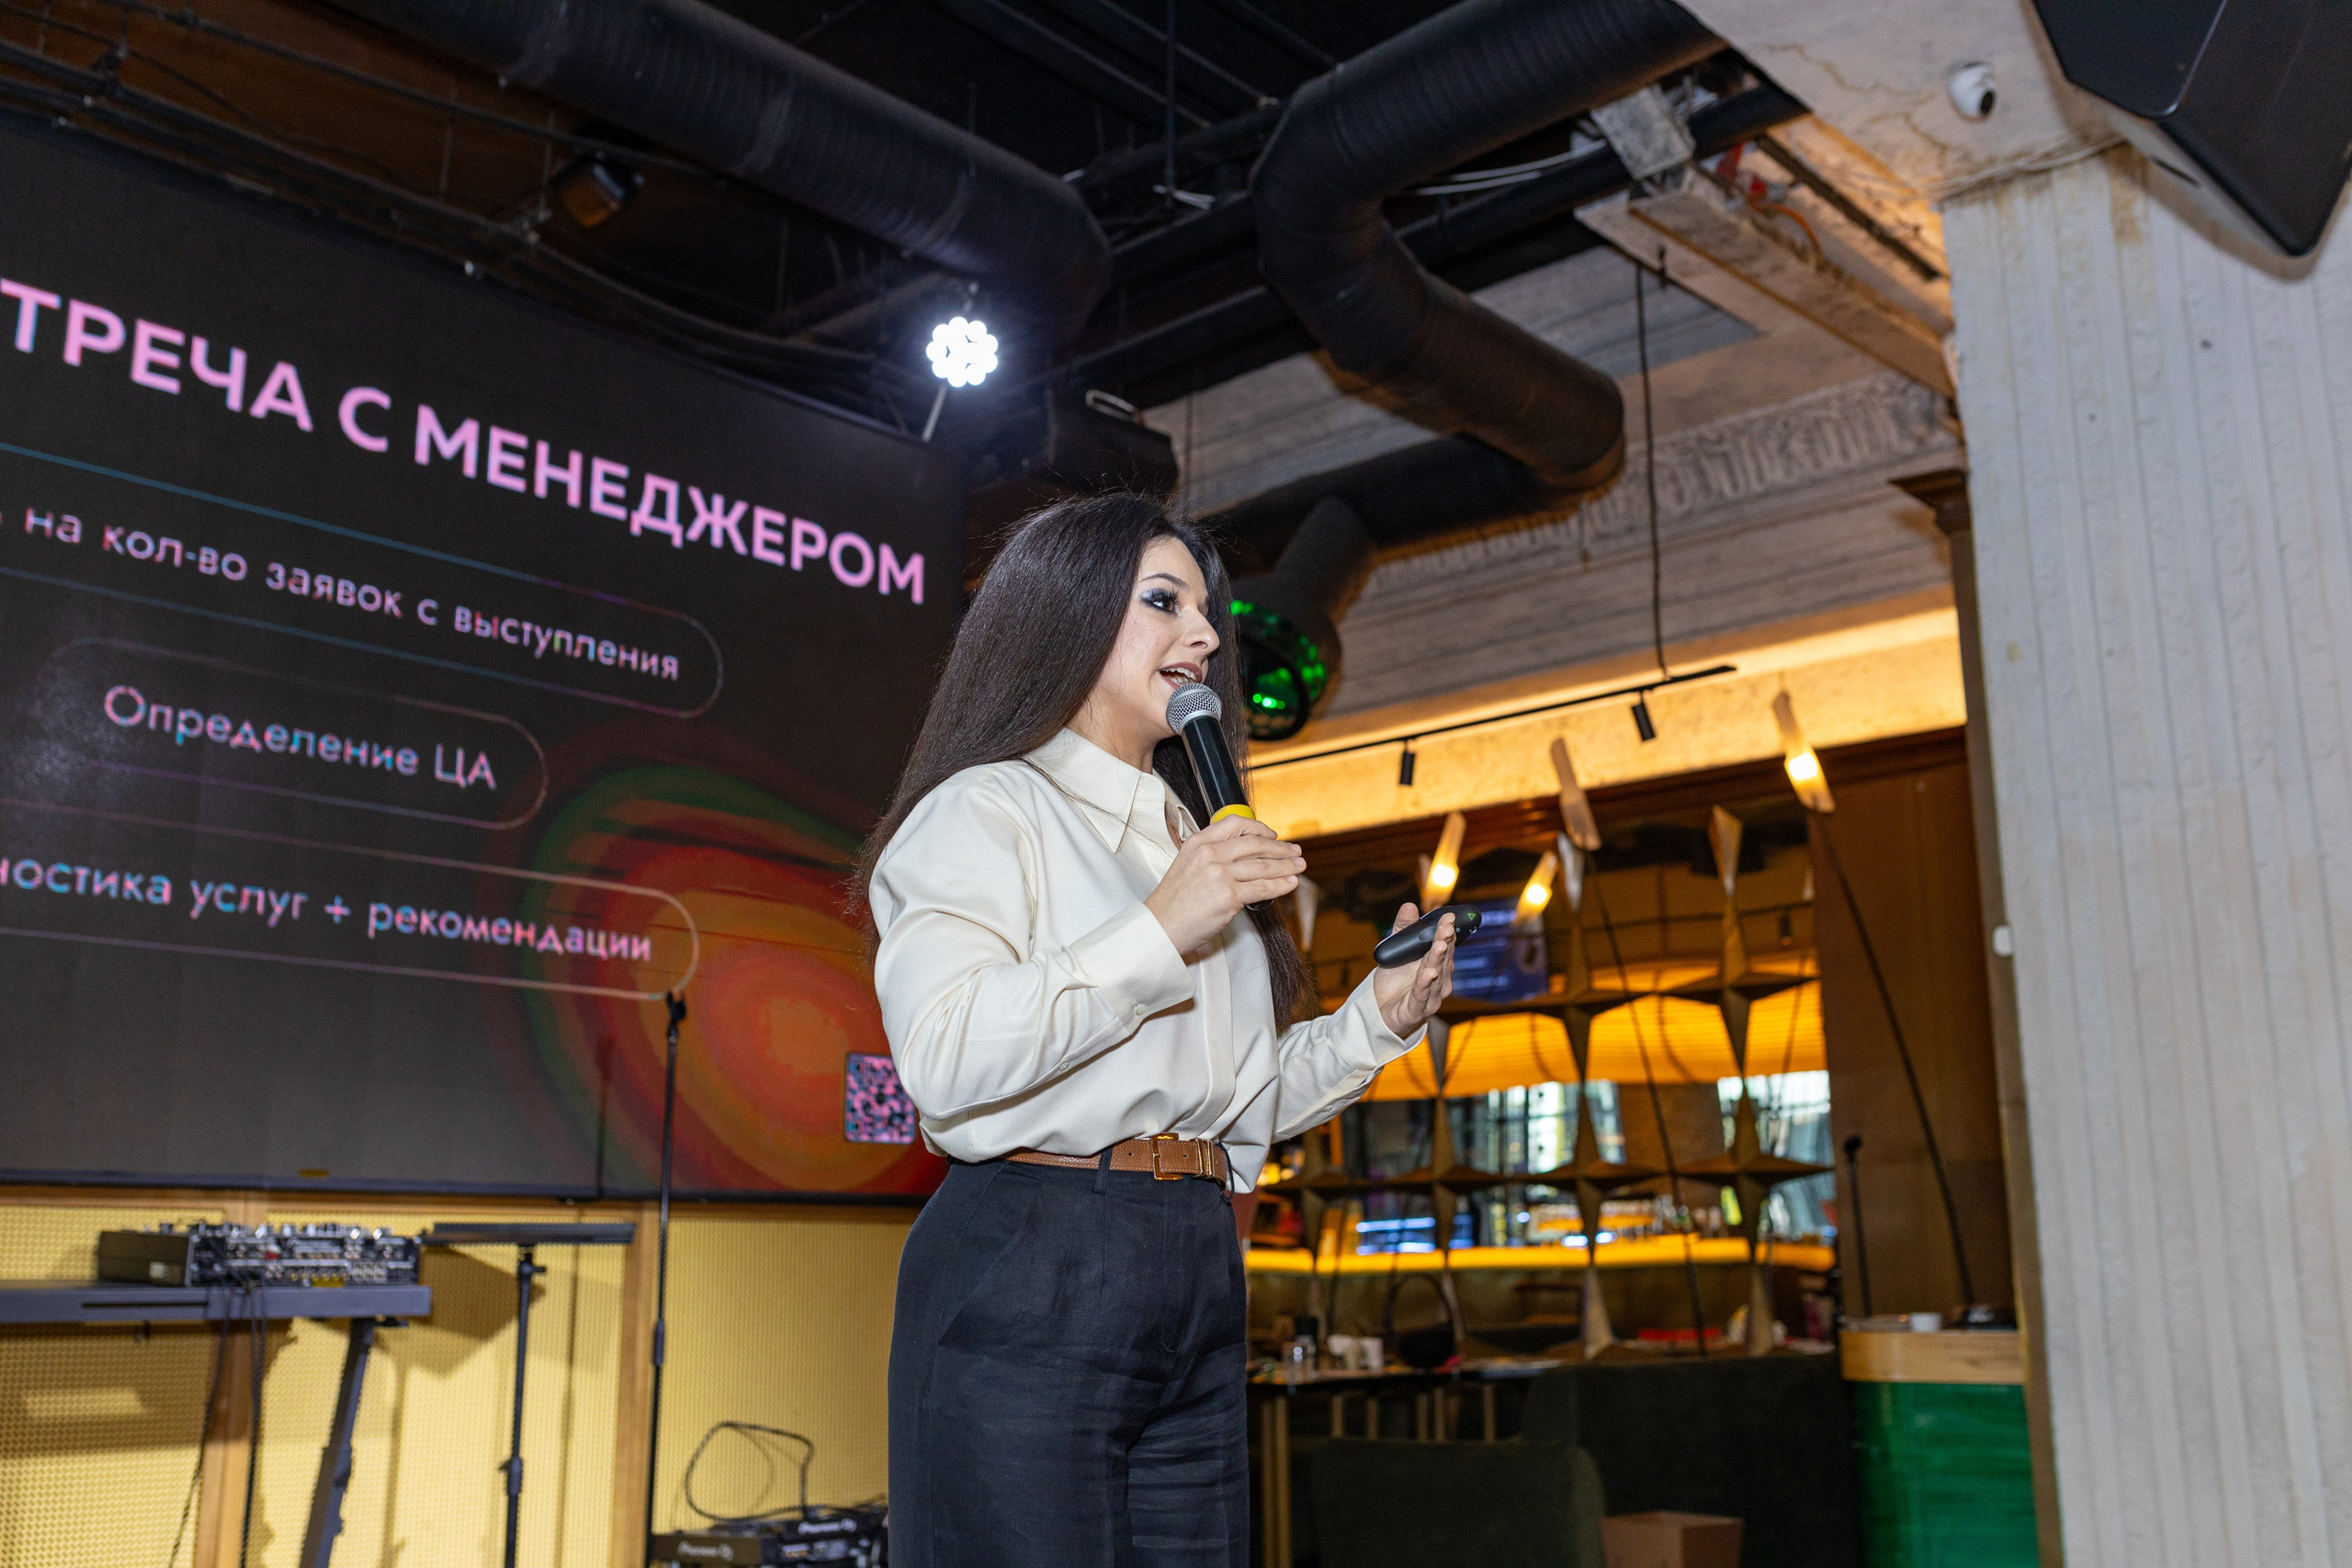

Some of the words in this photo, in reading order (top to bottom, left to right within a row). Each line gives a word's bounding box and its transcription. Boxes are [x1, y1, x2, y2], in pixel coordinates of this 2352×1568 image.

[0, 278, 313, 433] ТРЕЧА
[338, 387, 391, 453] С
[414, 404, 925, 605] МЕНЕДЖЕРОМ
[24, 507, 82, 544] на
[103, 525, 248, 581] кол-во
[266, 562, 402, 618] заявок
[416, 599, 439, 626] с
[454, 605, 679, 681] выступления
[104, 685, 419, 775] Определение
[435, 744, 497, 789] ЦА
[189, 879, 308, 927] услуг
[324, 896, 351, 924] +
[368, 903, 652, 964] рекомендации
